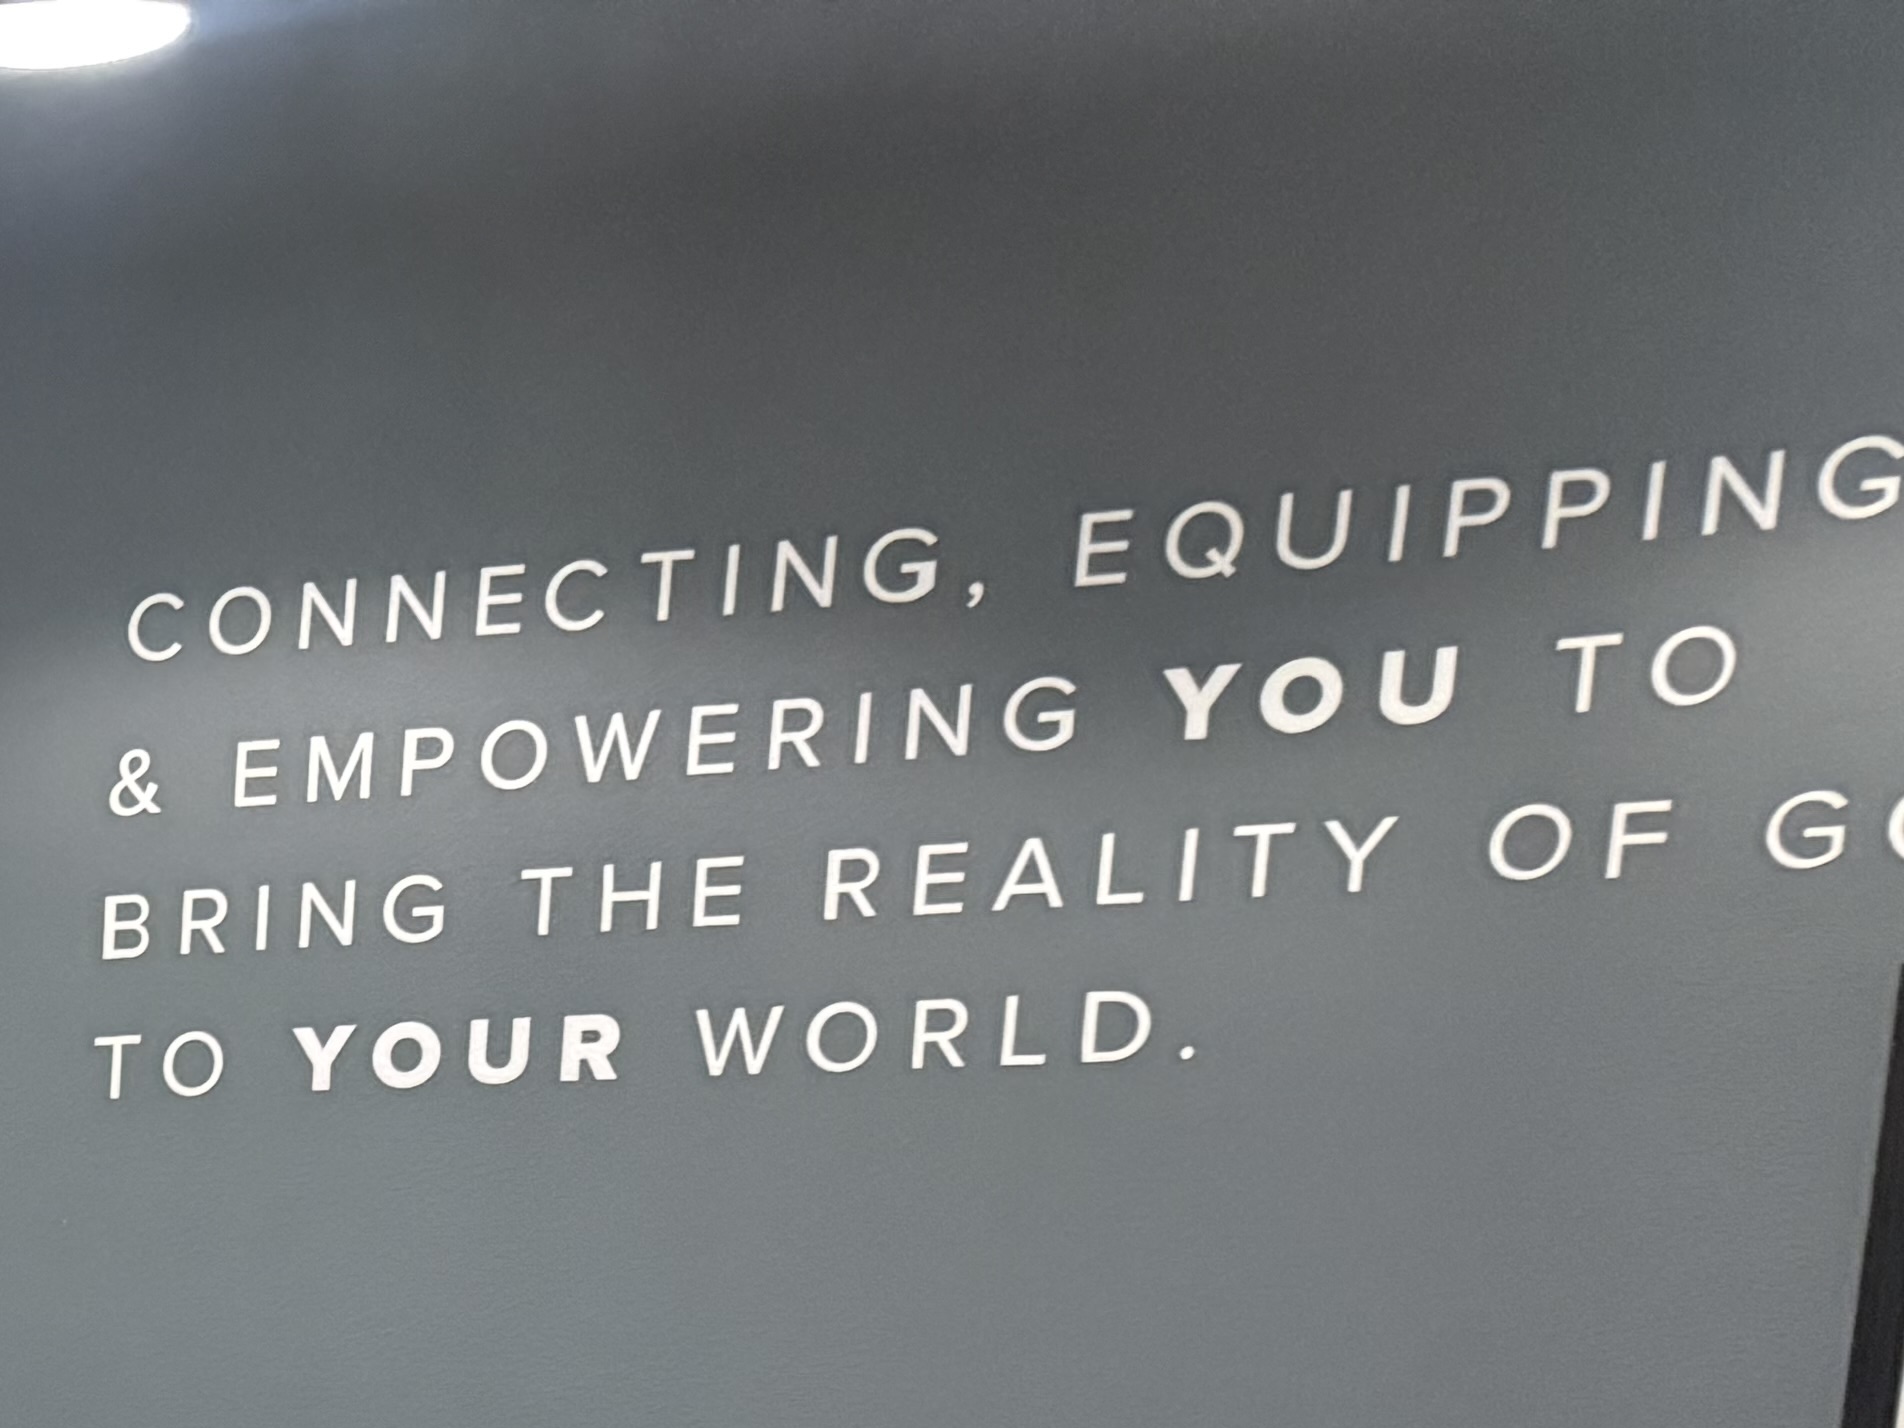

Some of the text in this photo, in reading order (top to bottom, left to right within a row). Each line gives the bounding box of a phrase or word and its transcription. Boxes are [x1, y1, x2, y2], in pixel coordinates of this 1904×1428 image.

[126, 435, 1904, 662] CONNECTING, EQUIPPING
[107, 625, 1738, 818] & EMPOWERING YOU TO
[101, 790, 1904, 961] BRING THE REALITY OF G
[92, 990, 1200, 1101] TO YOUR WORLD.
